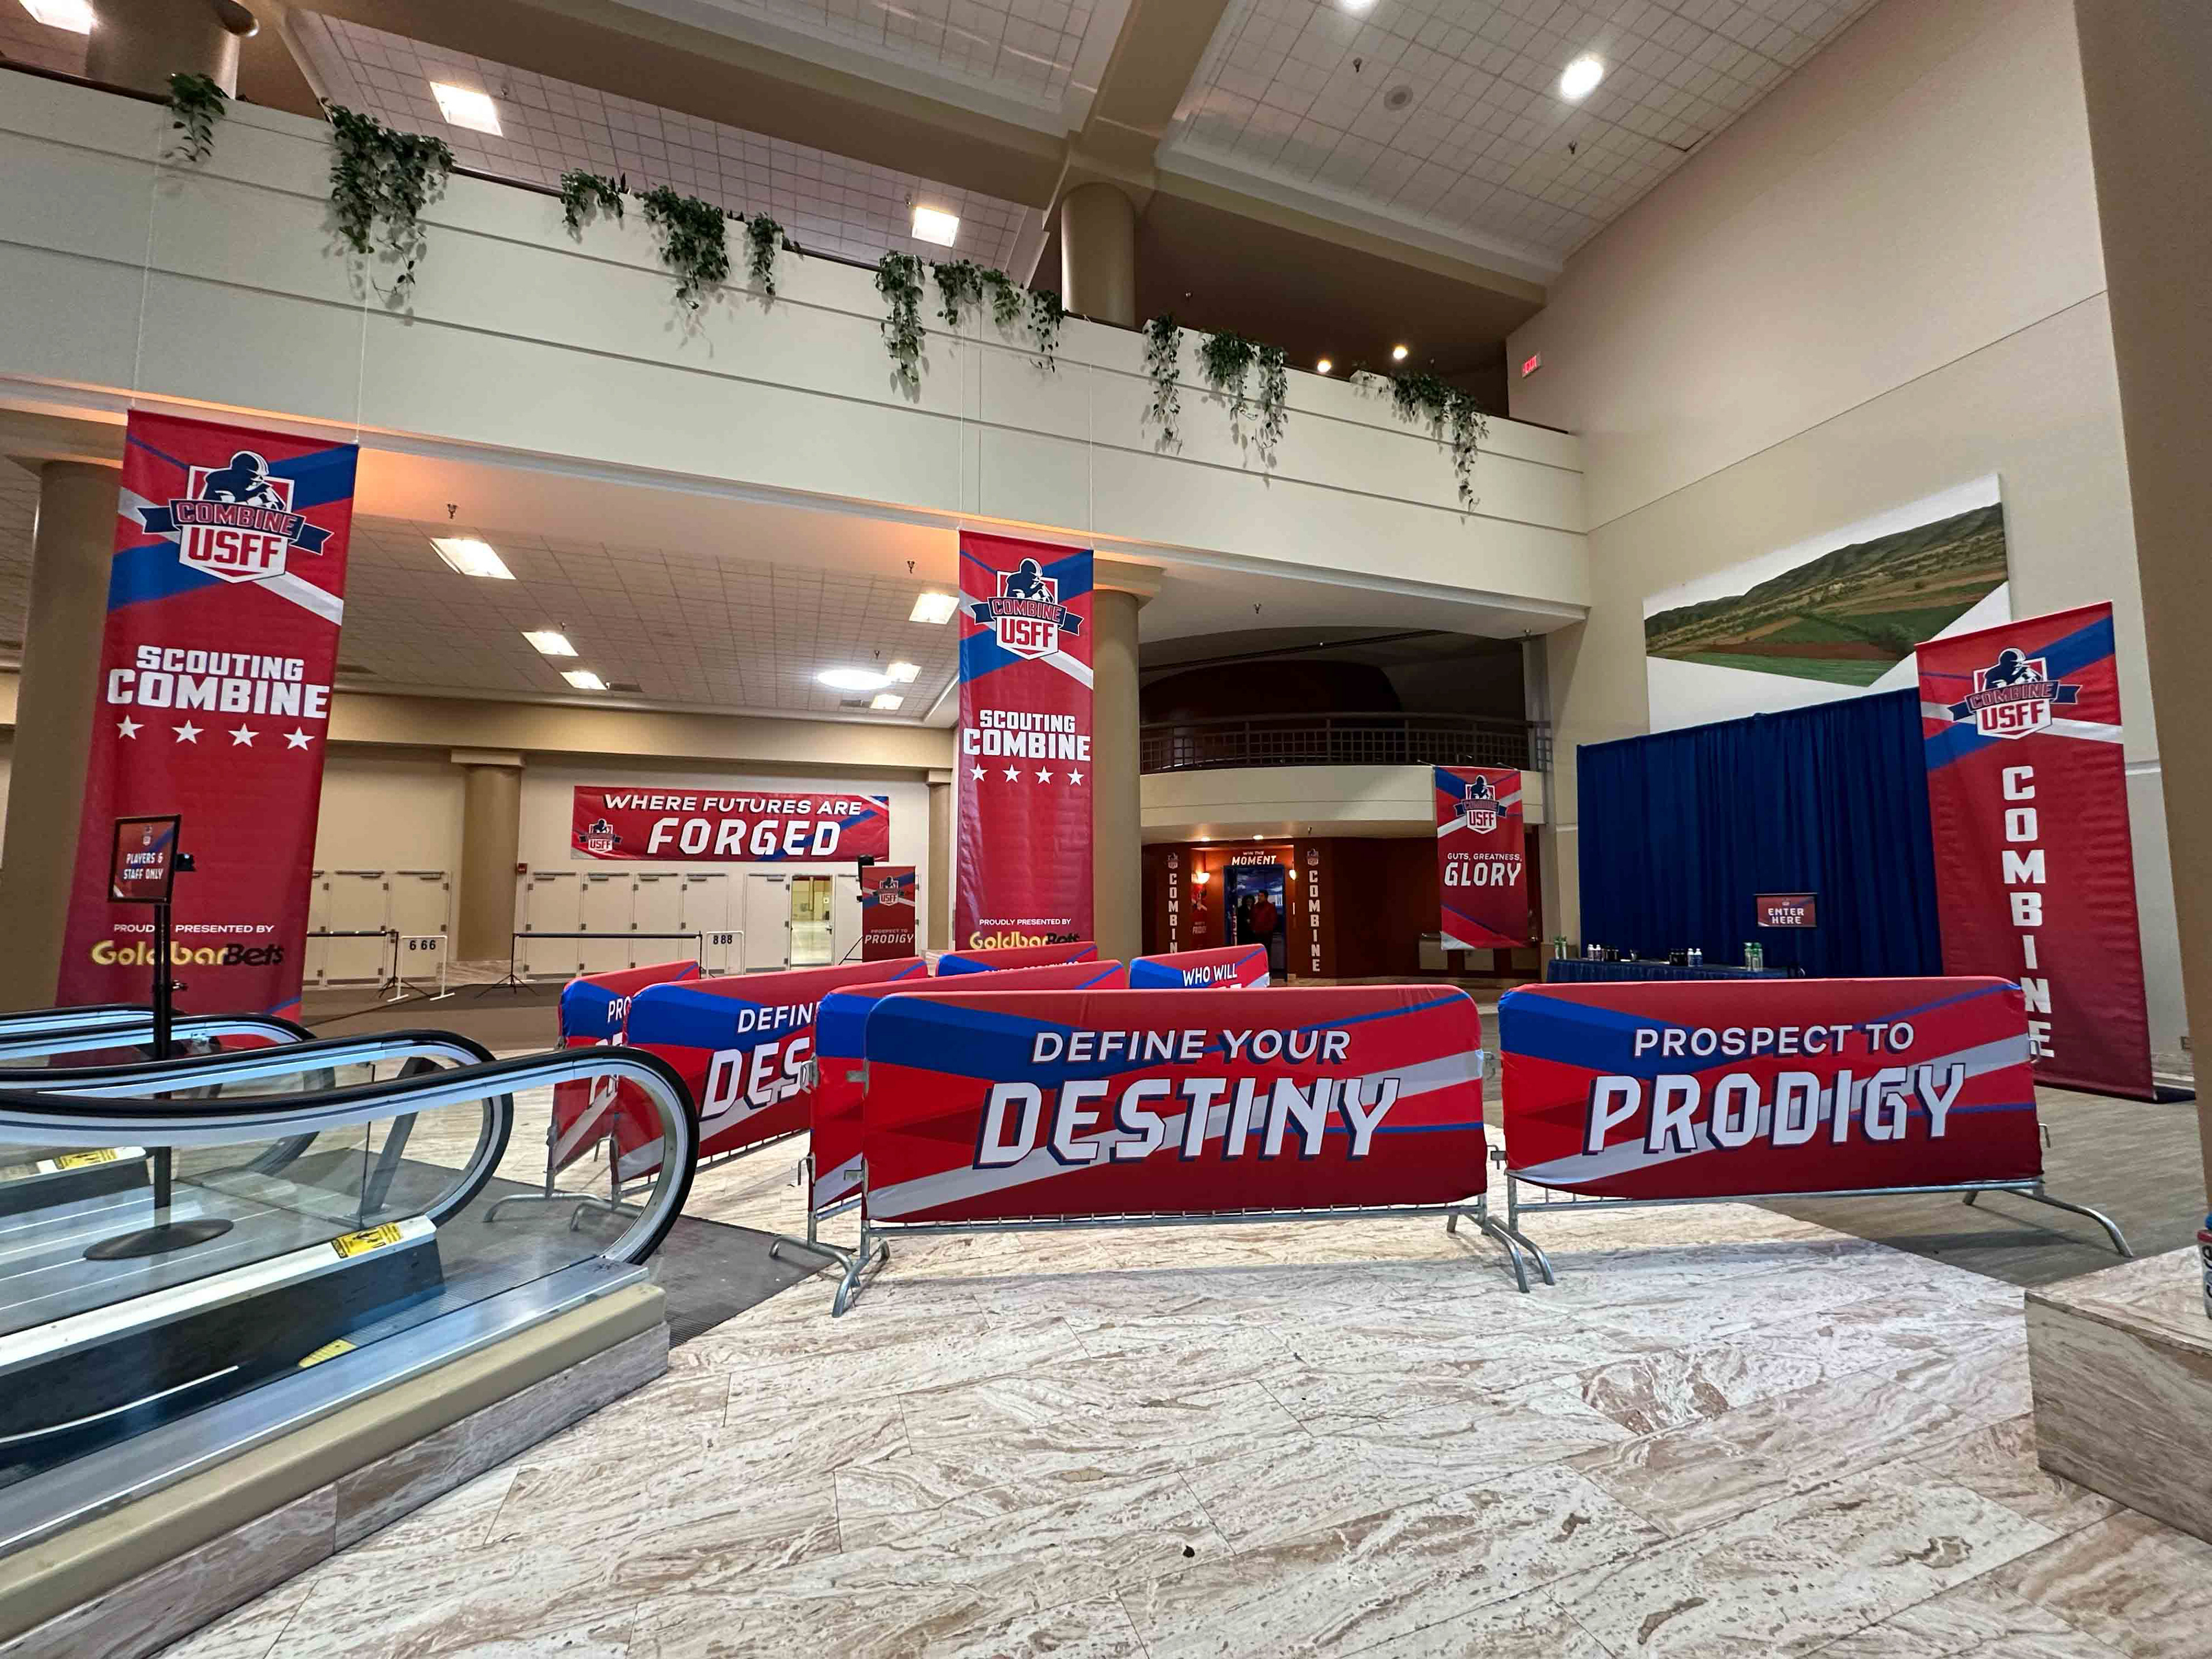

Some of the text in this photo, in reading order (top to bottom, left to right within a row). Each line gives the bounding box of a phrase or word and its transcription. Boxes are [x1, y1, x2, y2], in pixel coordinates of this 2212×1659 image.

[176, 502, 298, 536] COMBINE
[188, 527, 281, 568] USFF
[992, 599, 1061, 622] COMBINE
[1001, 618, 1054, 647] USFF
[136, 645, 304, 681] SCOUTING
[108, 669, 329, 719] COMBINE
[1970, 682, 2052, 709] COMBINE
[980, 710, 1075, 733] SCOUTING
[1982, 700, 2044, 730] USFF
[963, 729, 1090, 761] COMBINE
[605, 794, 861, 815] WHERE FUTURES ARE
[1469, 811, 1494, 826] USFF
[590, 840, 611, 849] USFF
[647, 817, 840, 856] FORGED
[126, 853, 154, 864] PLAYERS
[1232, 855, 1277, 865] MOMENT
[1448, 853, 1522, 862] GUTS, GREATNESS,
[123, 868, 164, 879] STAFF ONLY
[1444, 862, 1521, 886] GLORY
[1168, 873, 1178, 953] COMBIN
[1308, 870, 1320, 972] COMBINE
[1772, 916, 1802, 924] HERE
[2001, 765, 2055, 1058] COMBINE
[114, 924, 274, 933] PROUD PRESENTED BY
[865, 934, 914, 944] PRODIGY
[1183, 963, 1237, 986] WHO WILL
[737, 1001, 820, 1033] DEFIN
[1032, 1029, 1351, 1063] DEFINE YOUR
[1634, 1021, 1914, 1058] PROSPECT TO
[975, 1077, 1400, 1169] DESTINY
[1584, 1064, 1965, 1154] PRODIGY
